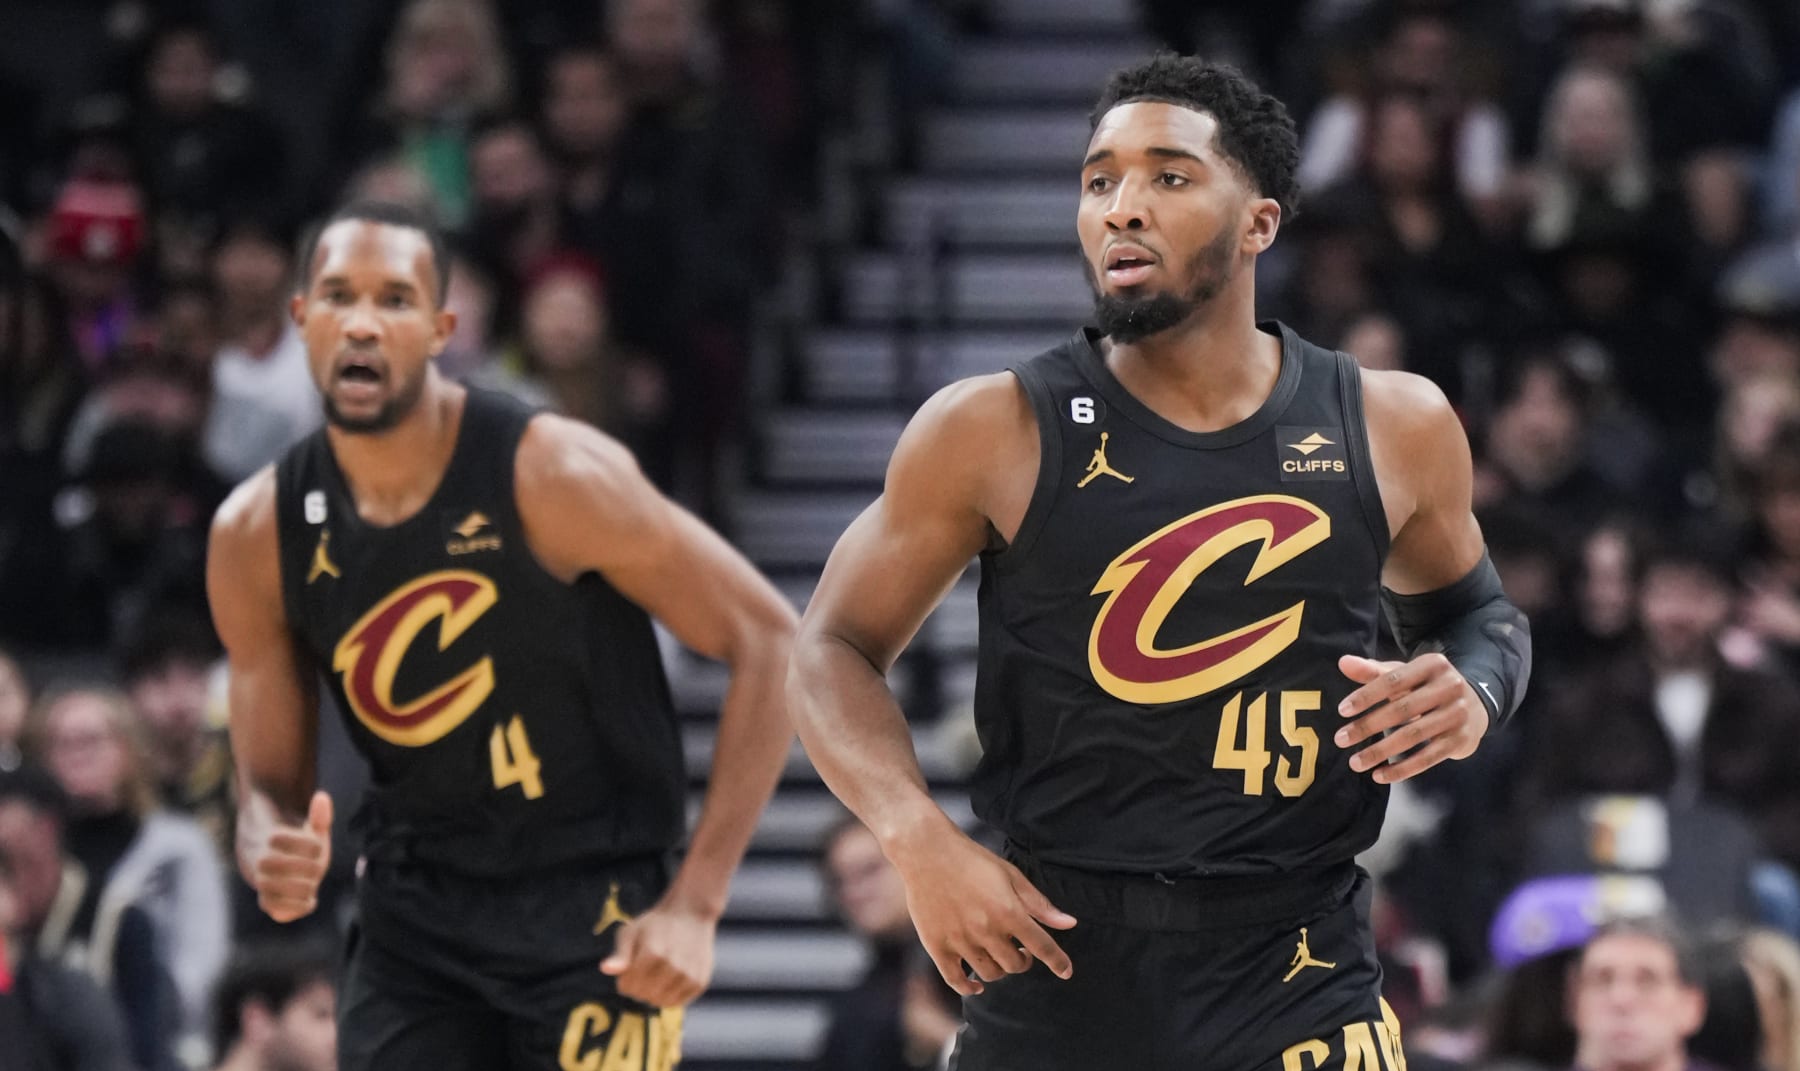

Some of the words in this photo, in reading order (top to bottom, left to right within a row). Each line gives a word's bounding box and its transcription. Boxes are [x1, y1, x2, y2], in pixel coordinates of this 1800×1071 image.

[1071, 397, 1095, 424] 6
[304, 490, 327, 524] 6
[1282, 459, 1345, 472] CLIFFS
[1088, 494, 1331, 704] C
[333, 569, 498, 747] C
[489, 713, 544, 799] 4
[1212, 690, 1322, 797] 45
